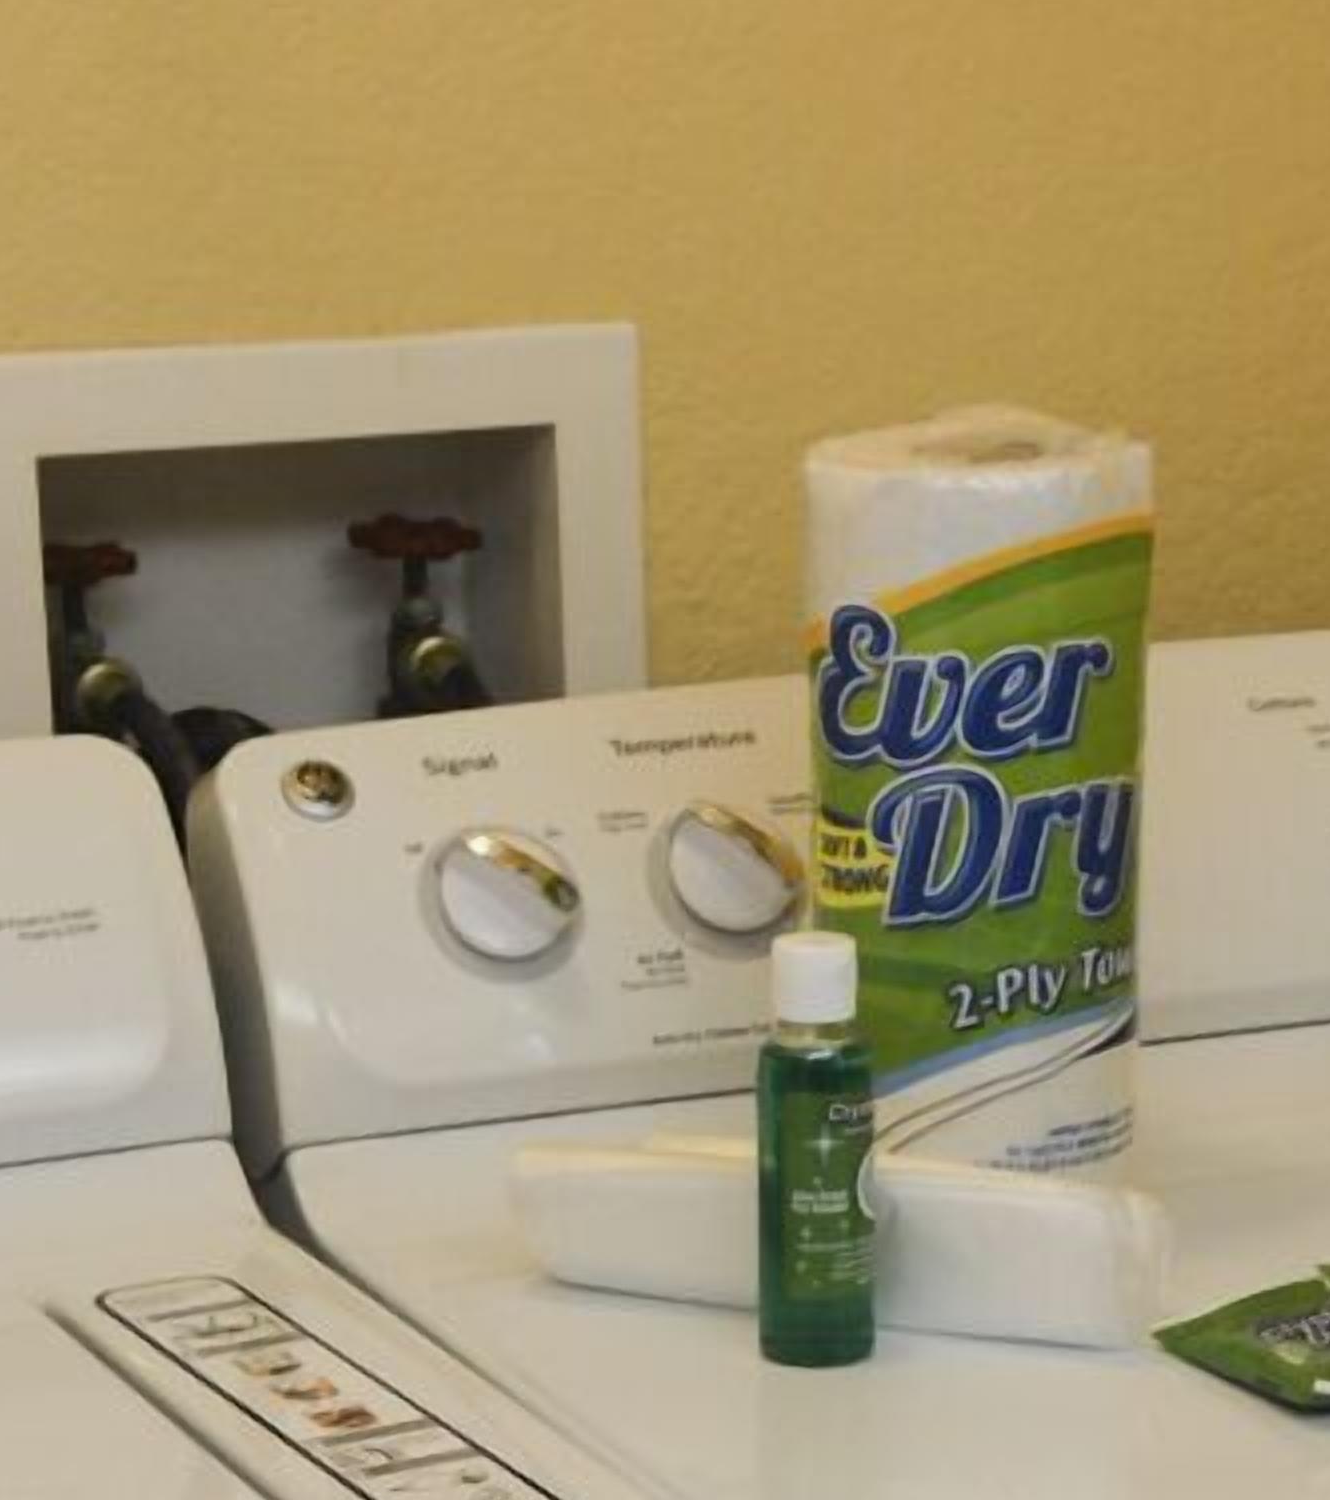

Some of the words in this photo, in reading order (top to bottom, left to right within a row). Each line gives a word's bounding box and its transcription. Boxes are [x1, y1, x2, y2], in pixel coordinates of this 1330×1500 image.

[819, 604, 1114, 768] Ever
[421, 752, 498, 778] Signal
[610, 729, 757, 758] Temperature
[866, 763, 1136, 926] Dry
[946, 962, 1068, 1030] 2-Ply
